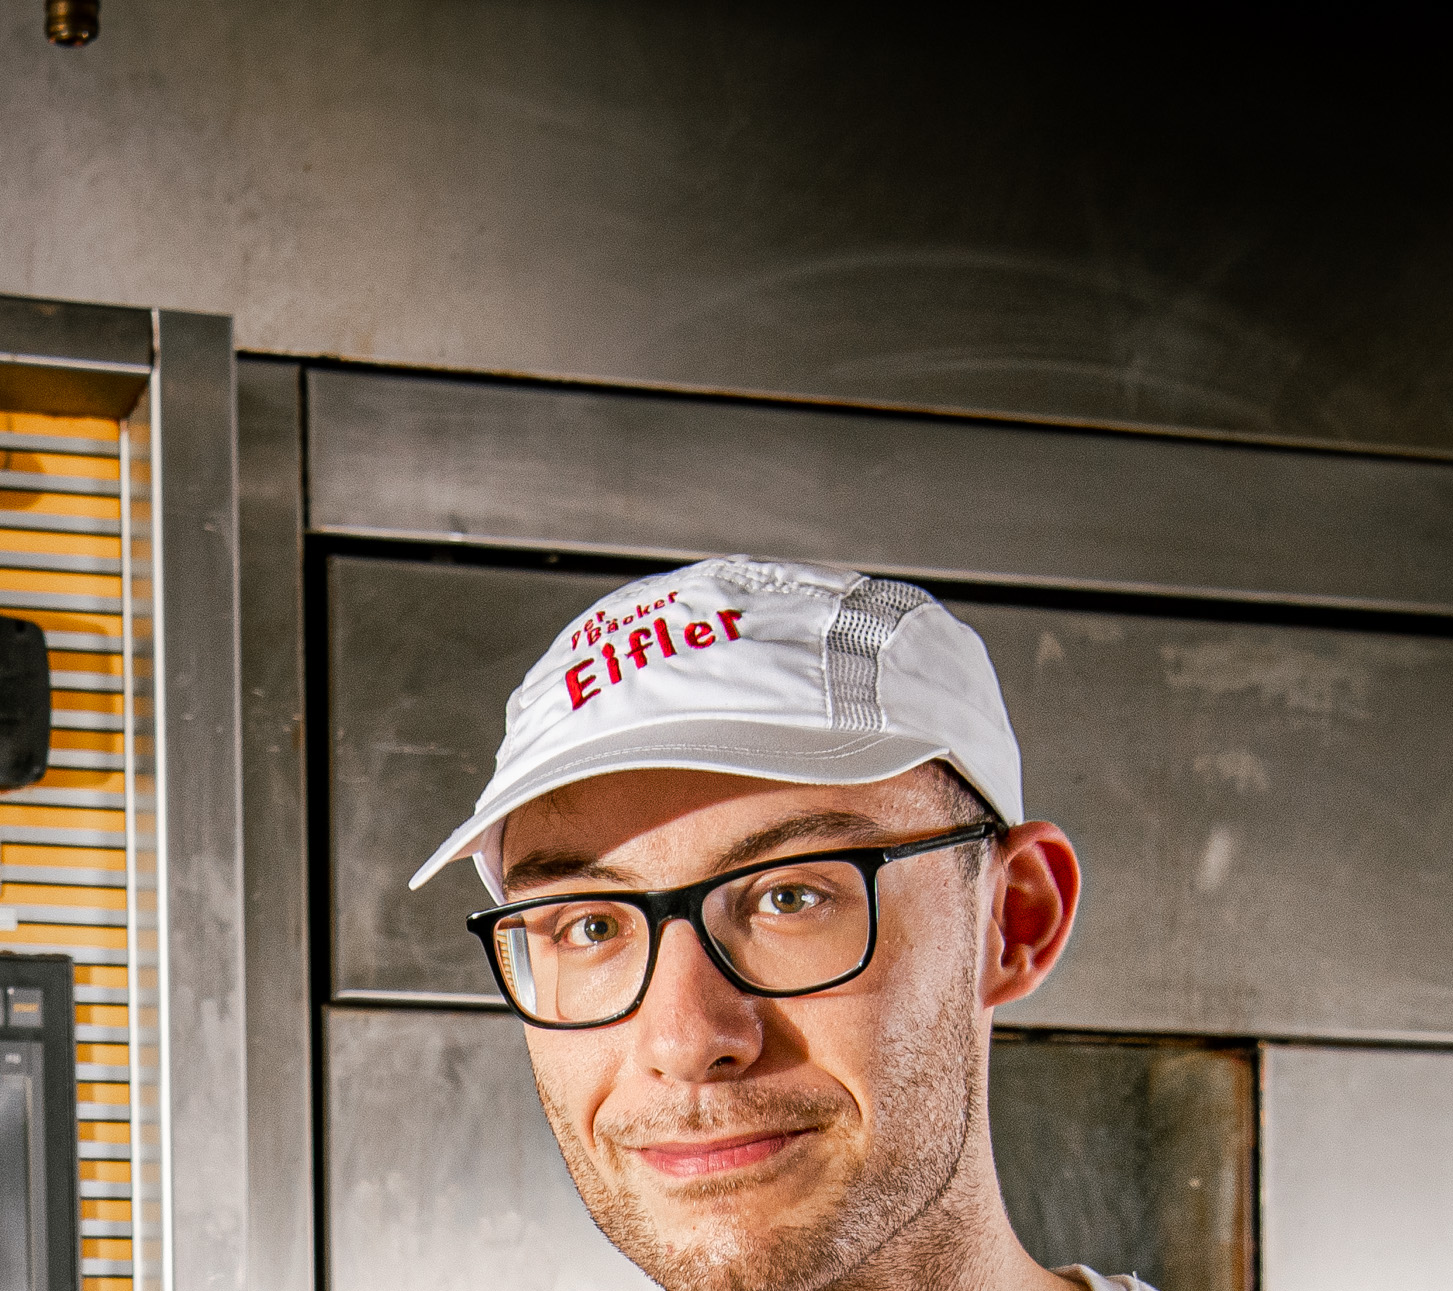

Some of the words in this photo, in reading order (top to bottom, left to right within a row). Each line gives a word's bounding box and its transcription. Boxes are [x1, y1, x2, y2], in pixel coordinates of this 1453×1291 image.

[571, 609, 607, 651] Der
[585, 591, 679, 645] Bäcker
[564, 608, 745, 711] Eifler
